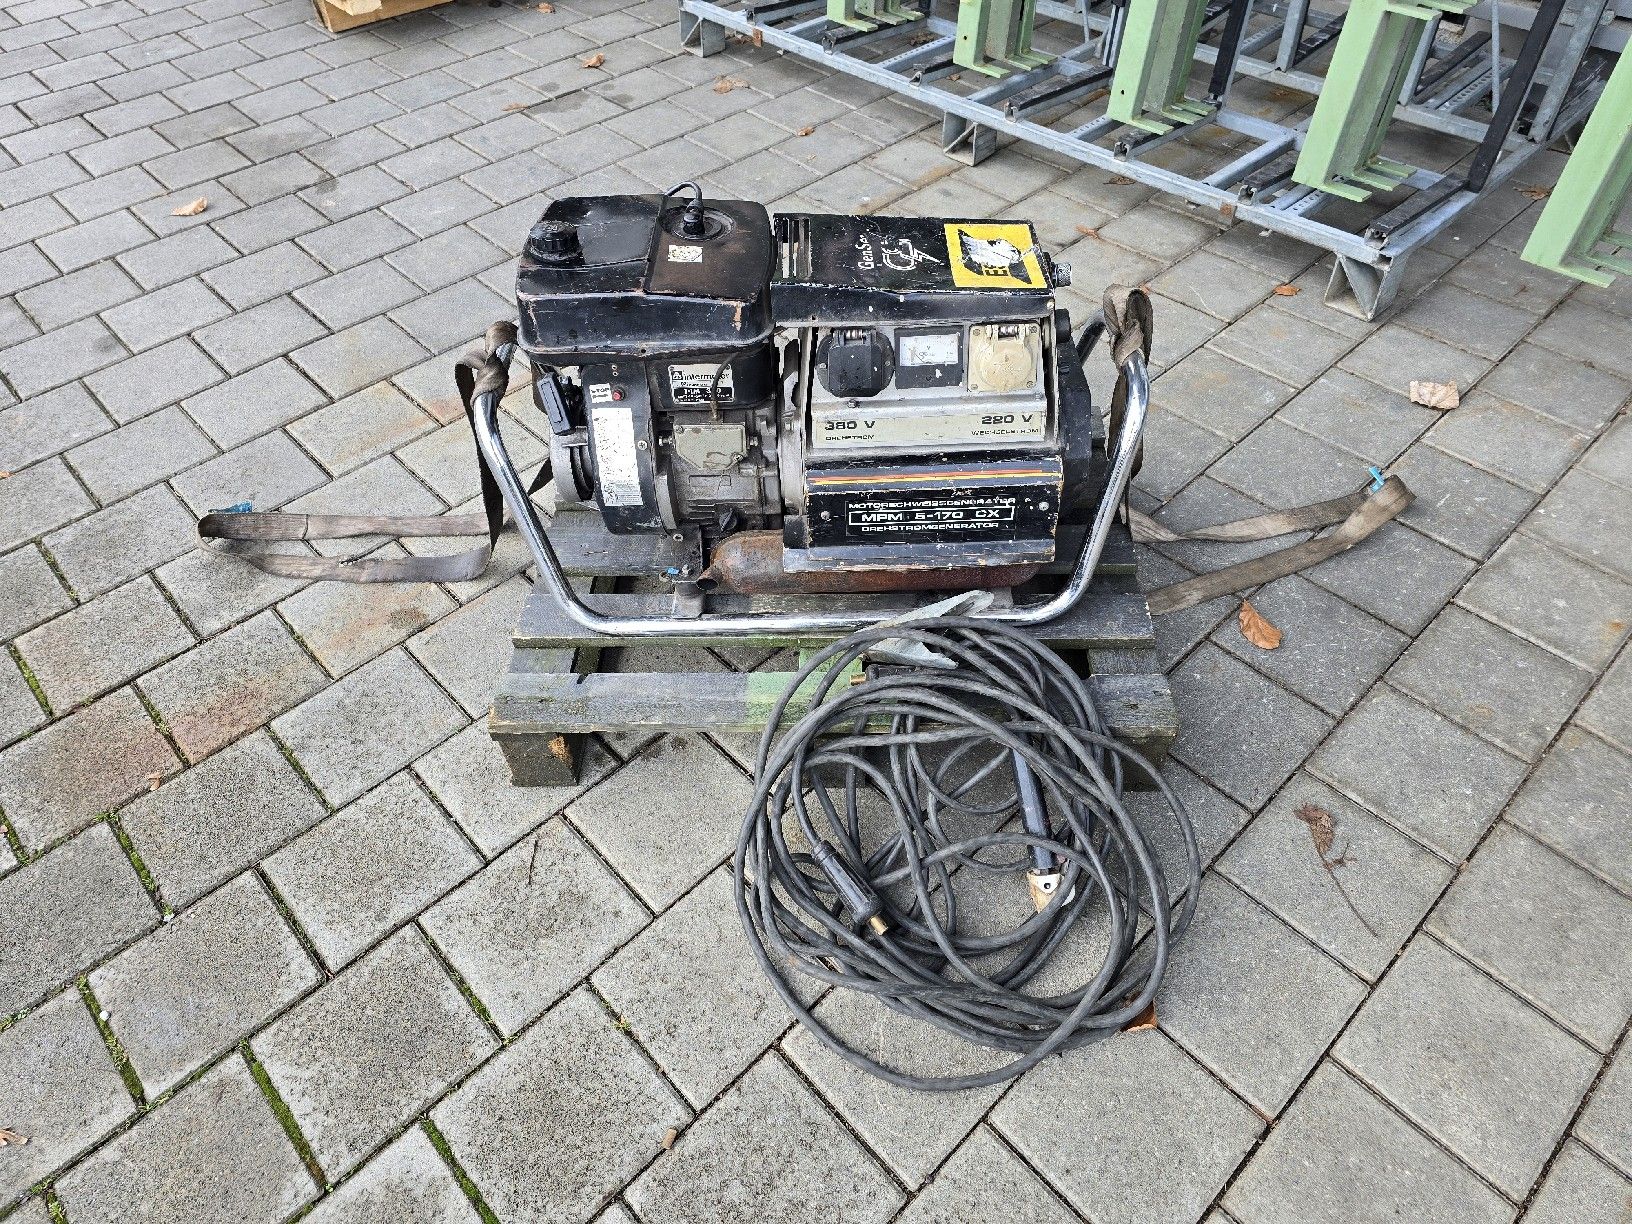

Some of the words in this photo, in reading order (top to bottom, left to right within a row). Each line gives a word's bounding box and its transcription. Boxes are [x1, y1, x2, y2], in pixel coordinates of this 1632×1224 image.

[981, 414, 1015, 425] 220
[1021, 413, 1034, 423] V
[825, 420, 858, 431] 380
[864, 420, 876, 429] V
[861, 513, 903, 522] MPM
[975, 509, 1000, 518] CX
[861, 522, 999, 532] DREHSTROMGENERATOR
